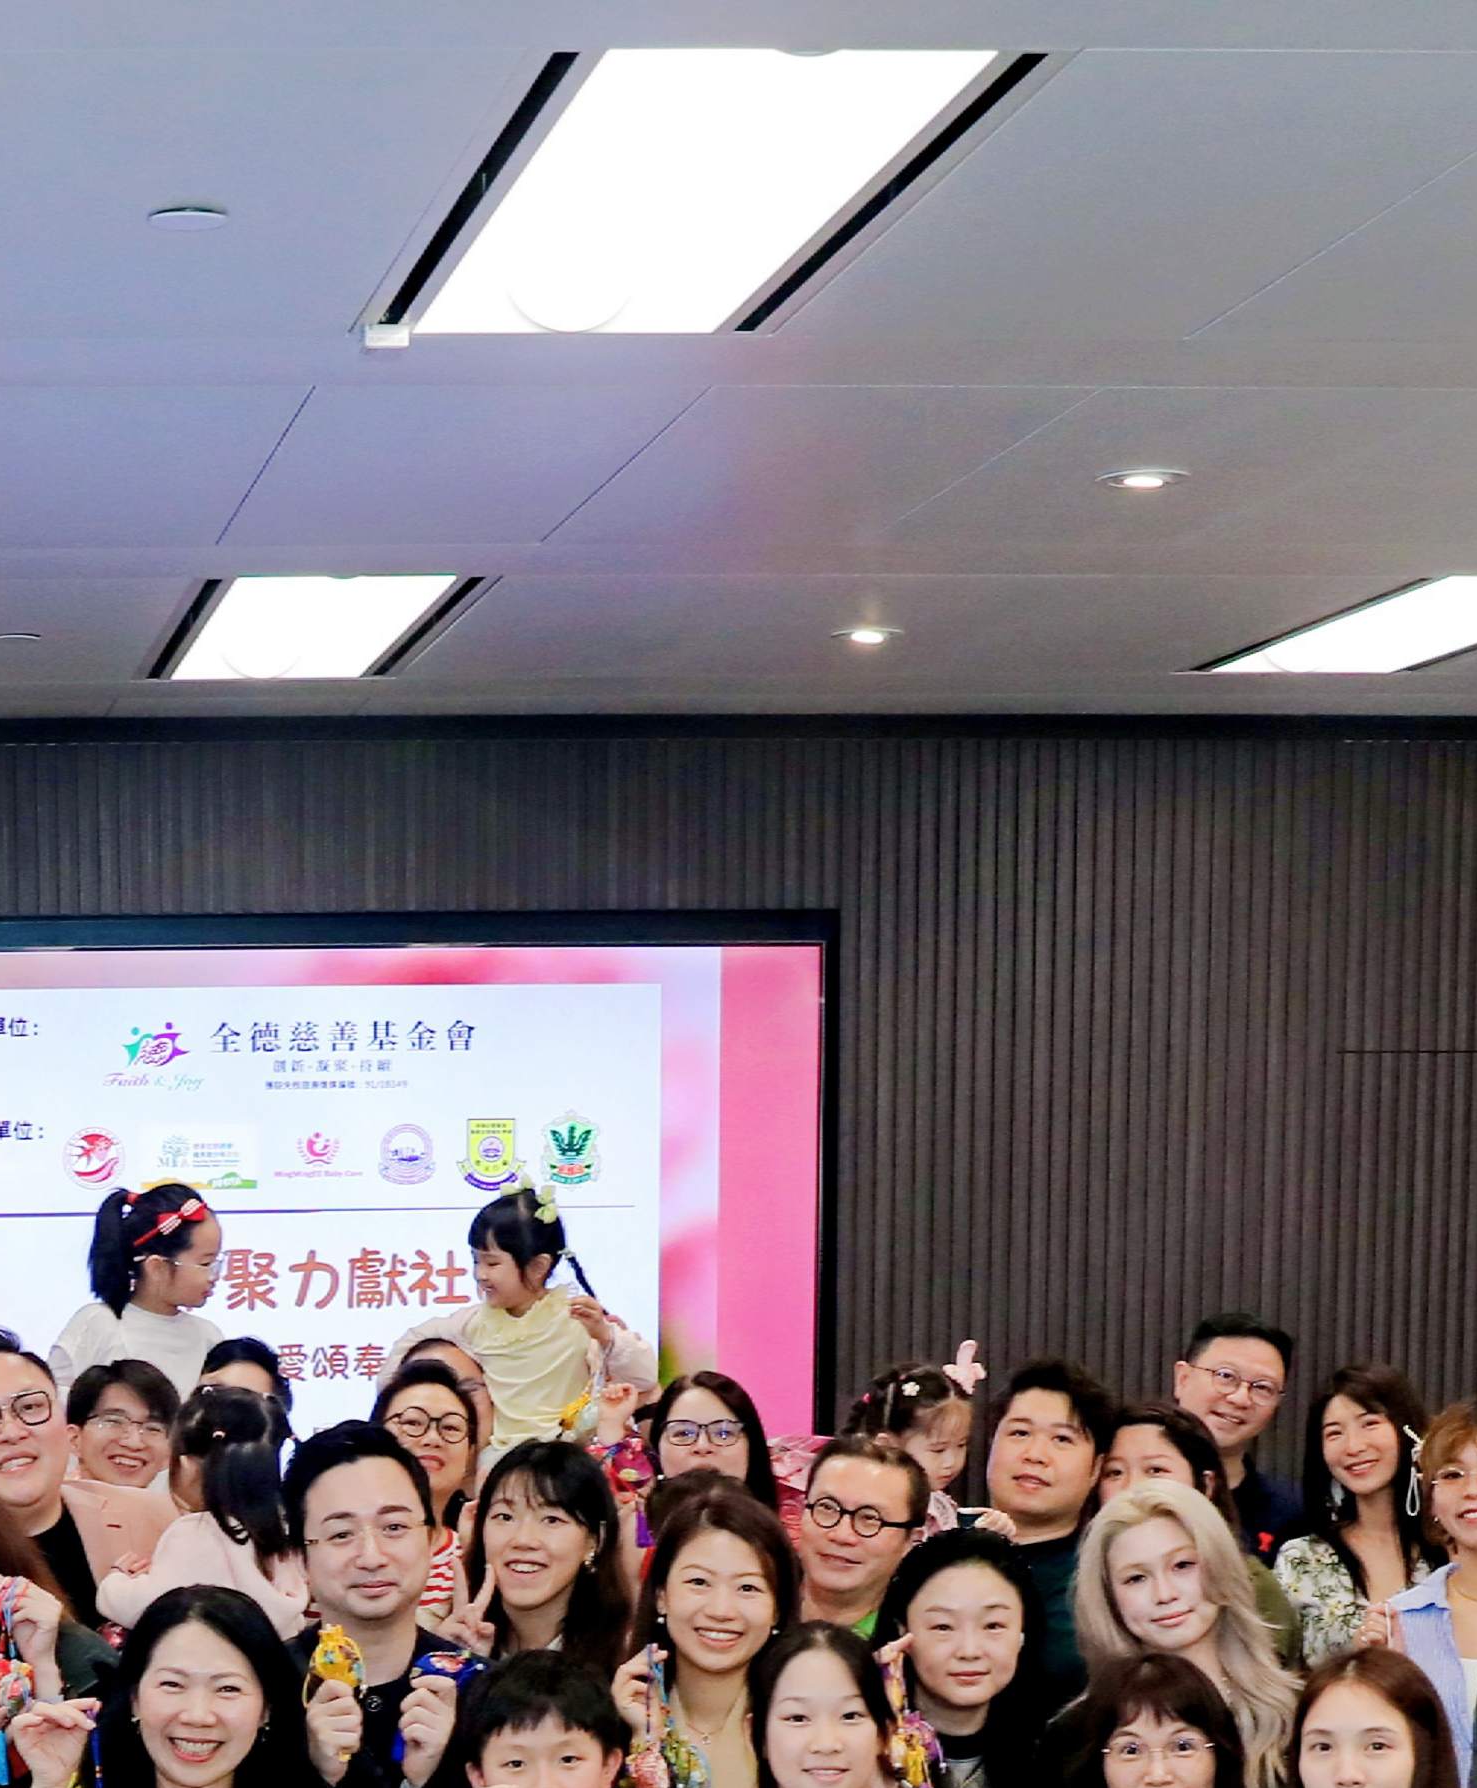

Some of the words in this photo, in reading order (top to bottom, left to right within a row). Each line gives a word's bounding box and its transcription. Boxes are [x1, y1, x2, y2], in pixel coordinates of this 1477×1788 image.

[209, 1019, 476, 1053] 全德慈善基金會
[221, 1247, 481, 1311] 聚力獻社
